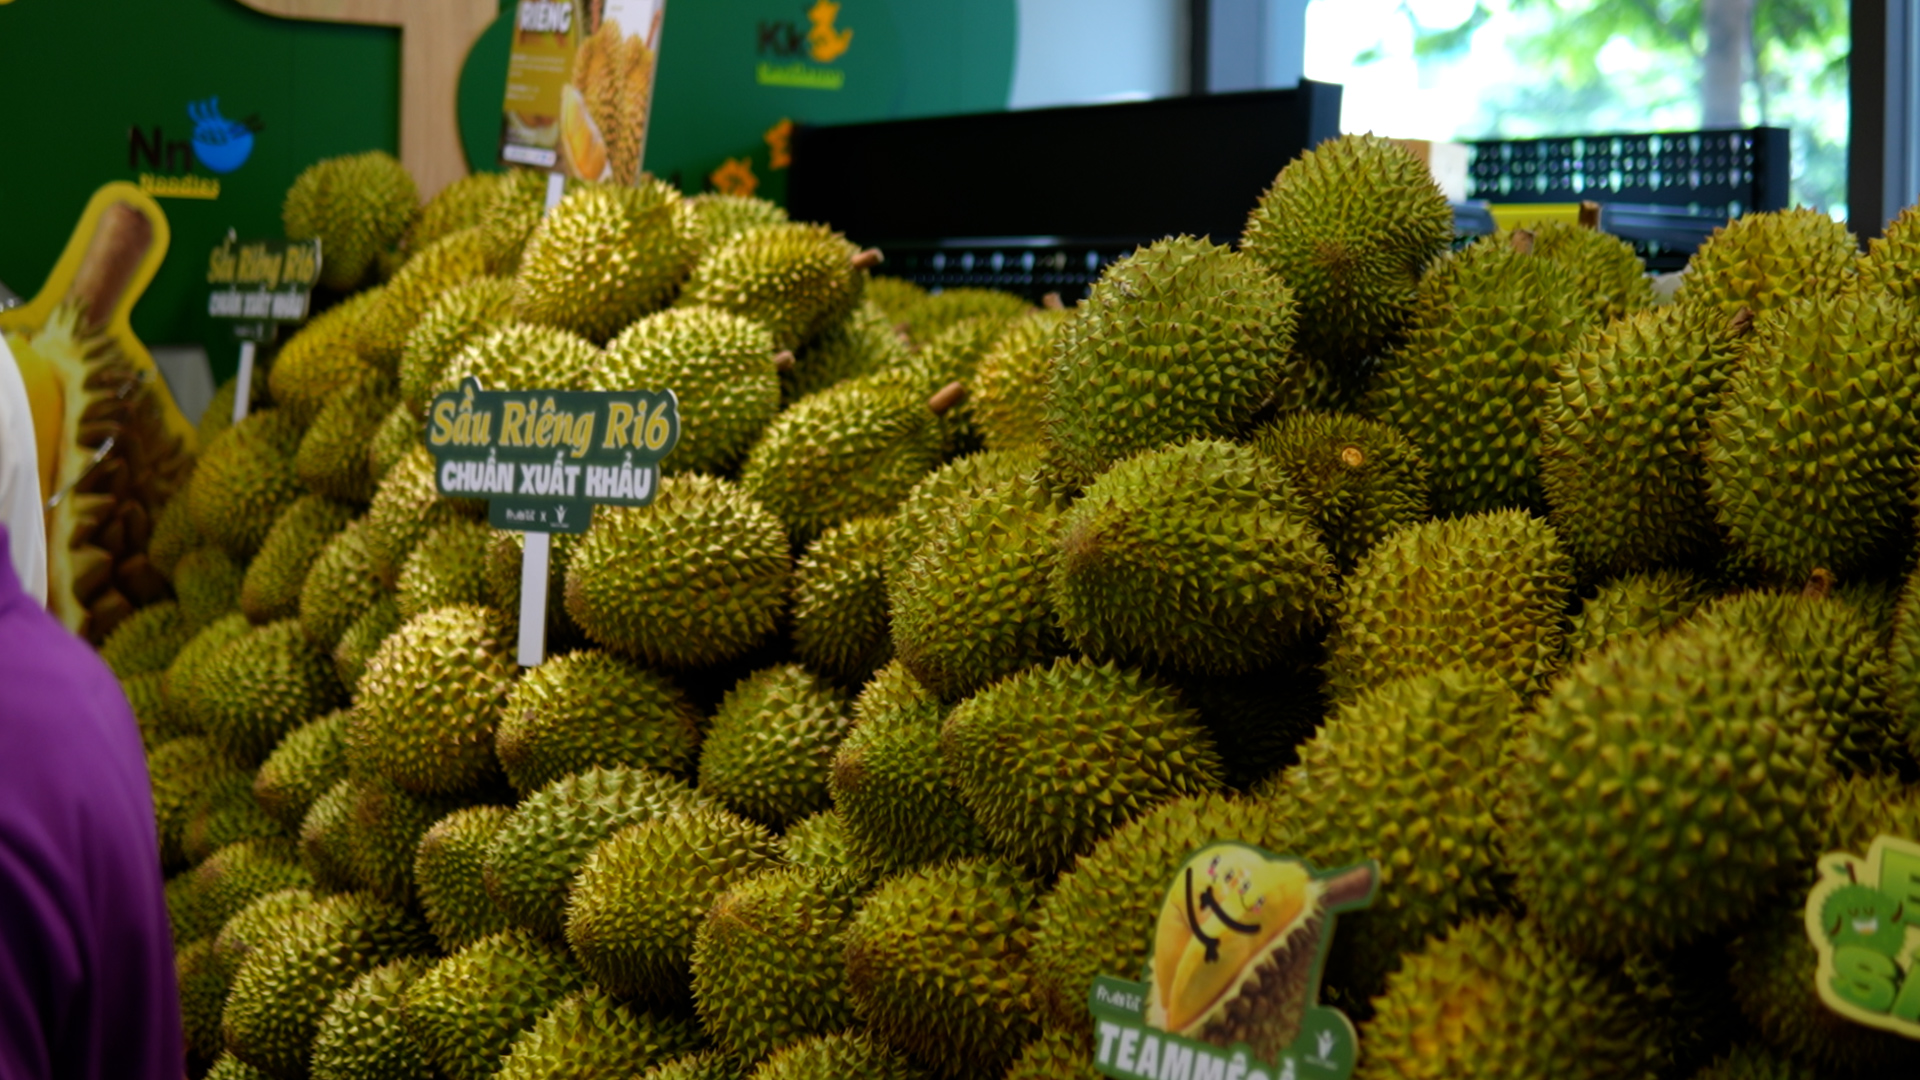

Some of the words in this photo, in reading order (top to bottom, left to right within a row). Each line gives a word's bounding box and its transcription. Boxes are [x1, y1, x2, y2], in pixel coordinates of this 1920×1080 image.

[130, 125, 192, 172] Nn
[430, 385, 491, 446] Sầu
[498, 396, 595, 458] Riêng
[602, 399, 670, 450] Ri6
[441, 447, 514, 493] CHUẨN
[519, 451, 581, 496] XUẤT
[585, 451, 651, 499] KHẨU
